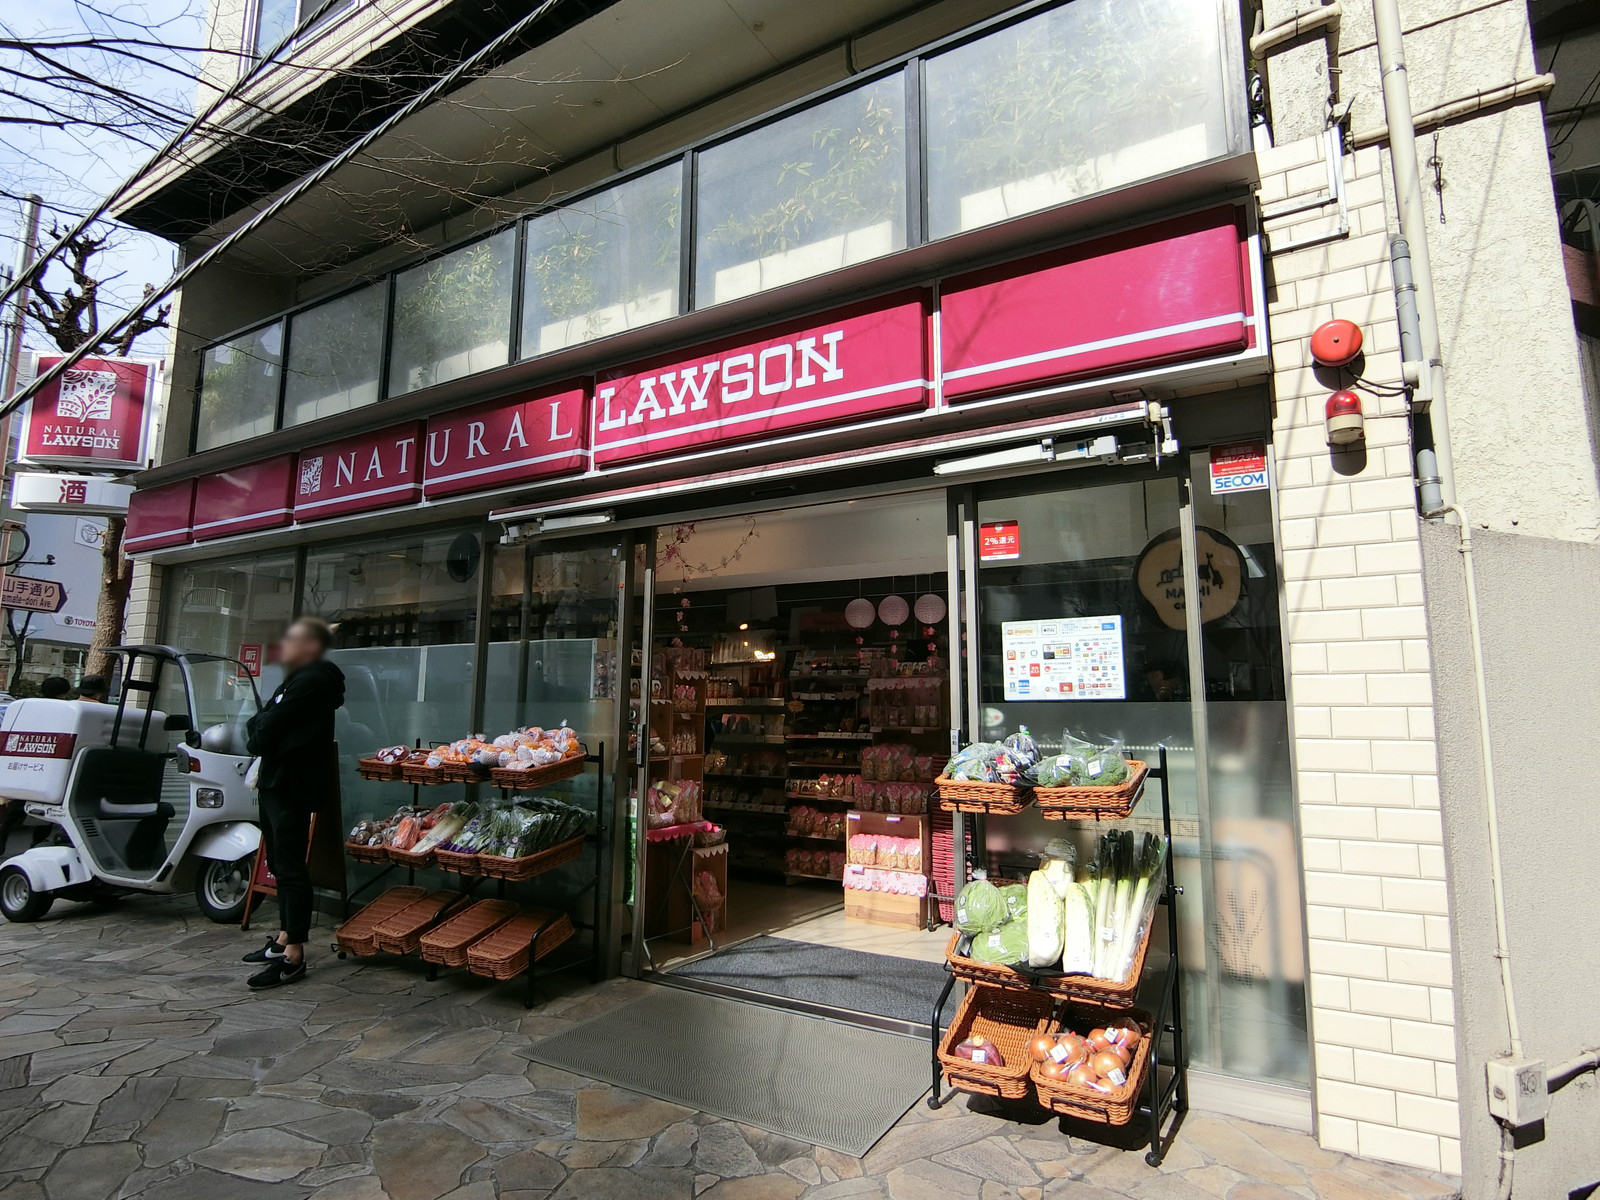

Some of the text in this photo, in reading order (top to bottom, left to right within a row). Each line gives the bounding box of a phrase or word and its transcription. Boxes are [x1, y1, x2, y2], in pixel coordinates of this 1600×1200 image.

[333, 329, 844, 488] NATURAL LAWSON
[44, 425, 121, 438] NATURAL
[42, 434, 121, 450] LAWSON
[1214, 473, 1264, 489] SECOM
[58, 479, 89, 504] 酒
[3, 578, 55, 598] 山手通り
[1165, 585, 1210, 599] MAHI
[74, 618, 97, 628] TOYOTA
[19, 735, 58, 744] NATURAL
[17, 742, 57, 754] LAWSON
